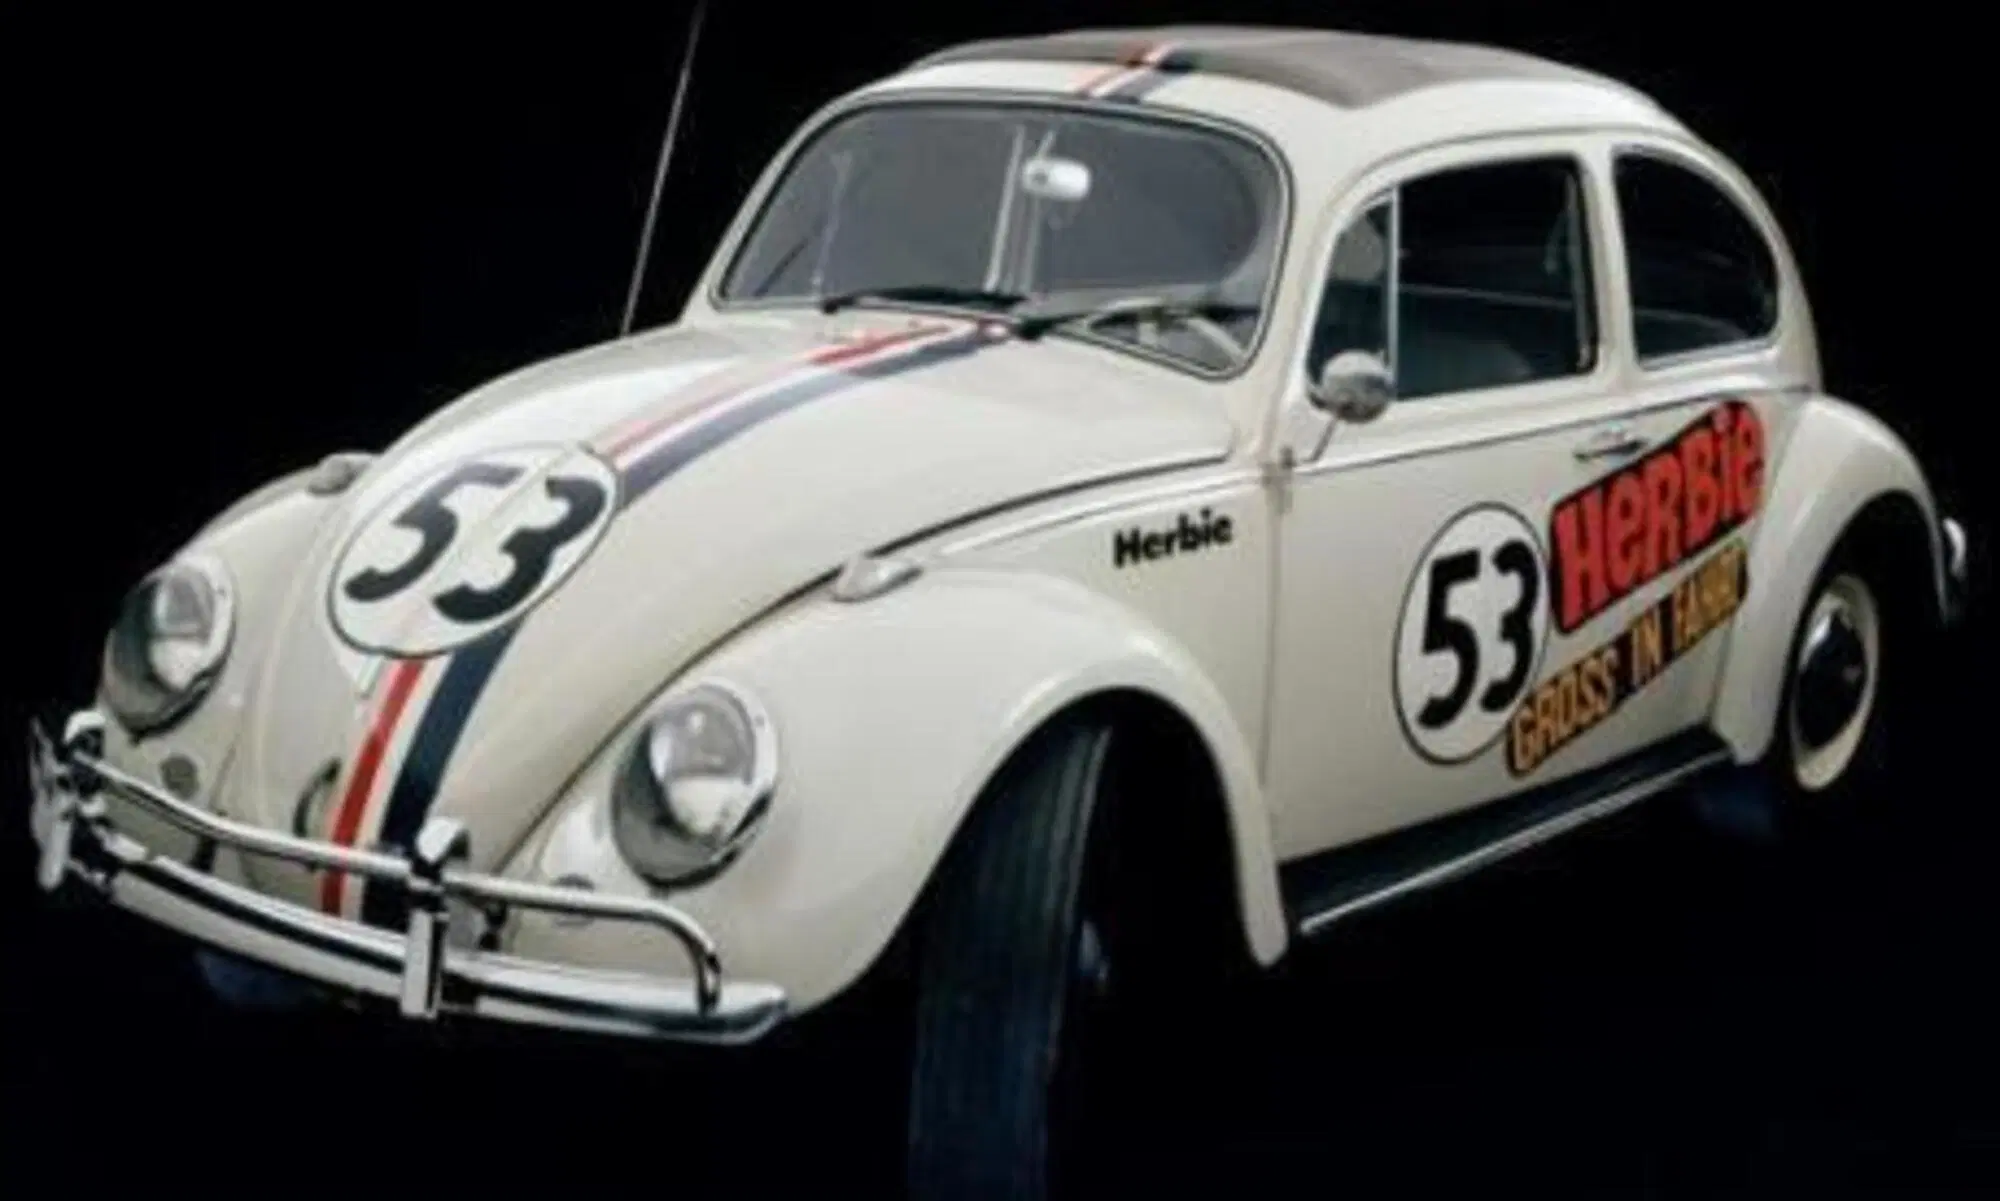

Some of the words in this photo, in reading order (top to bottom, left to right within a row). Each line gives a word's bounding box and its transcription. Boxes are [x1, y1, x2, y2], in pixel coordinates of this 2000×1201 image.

[343, 461, 608, 625] 53
[1113, 507, 1233, 568] Herbie
[1417, 538, 1541, 729] 53
[1512, 648, 1617, 772] GROSS
[1631, 605, 1662, 688] IN
